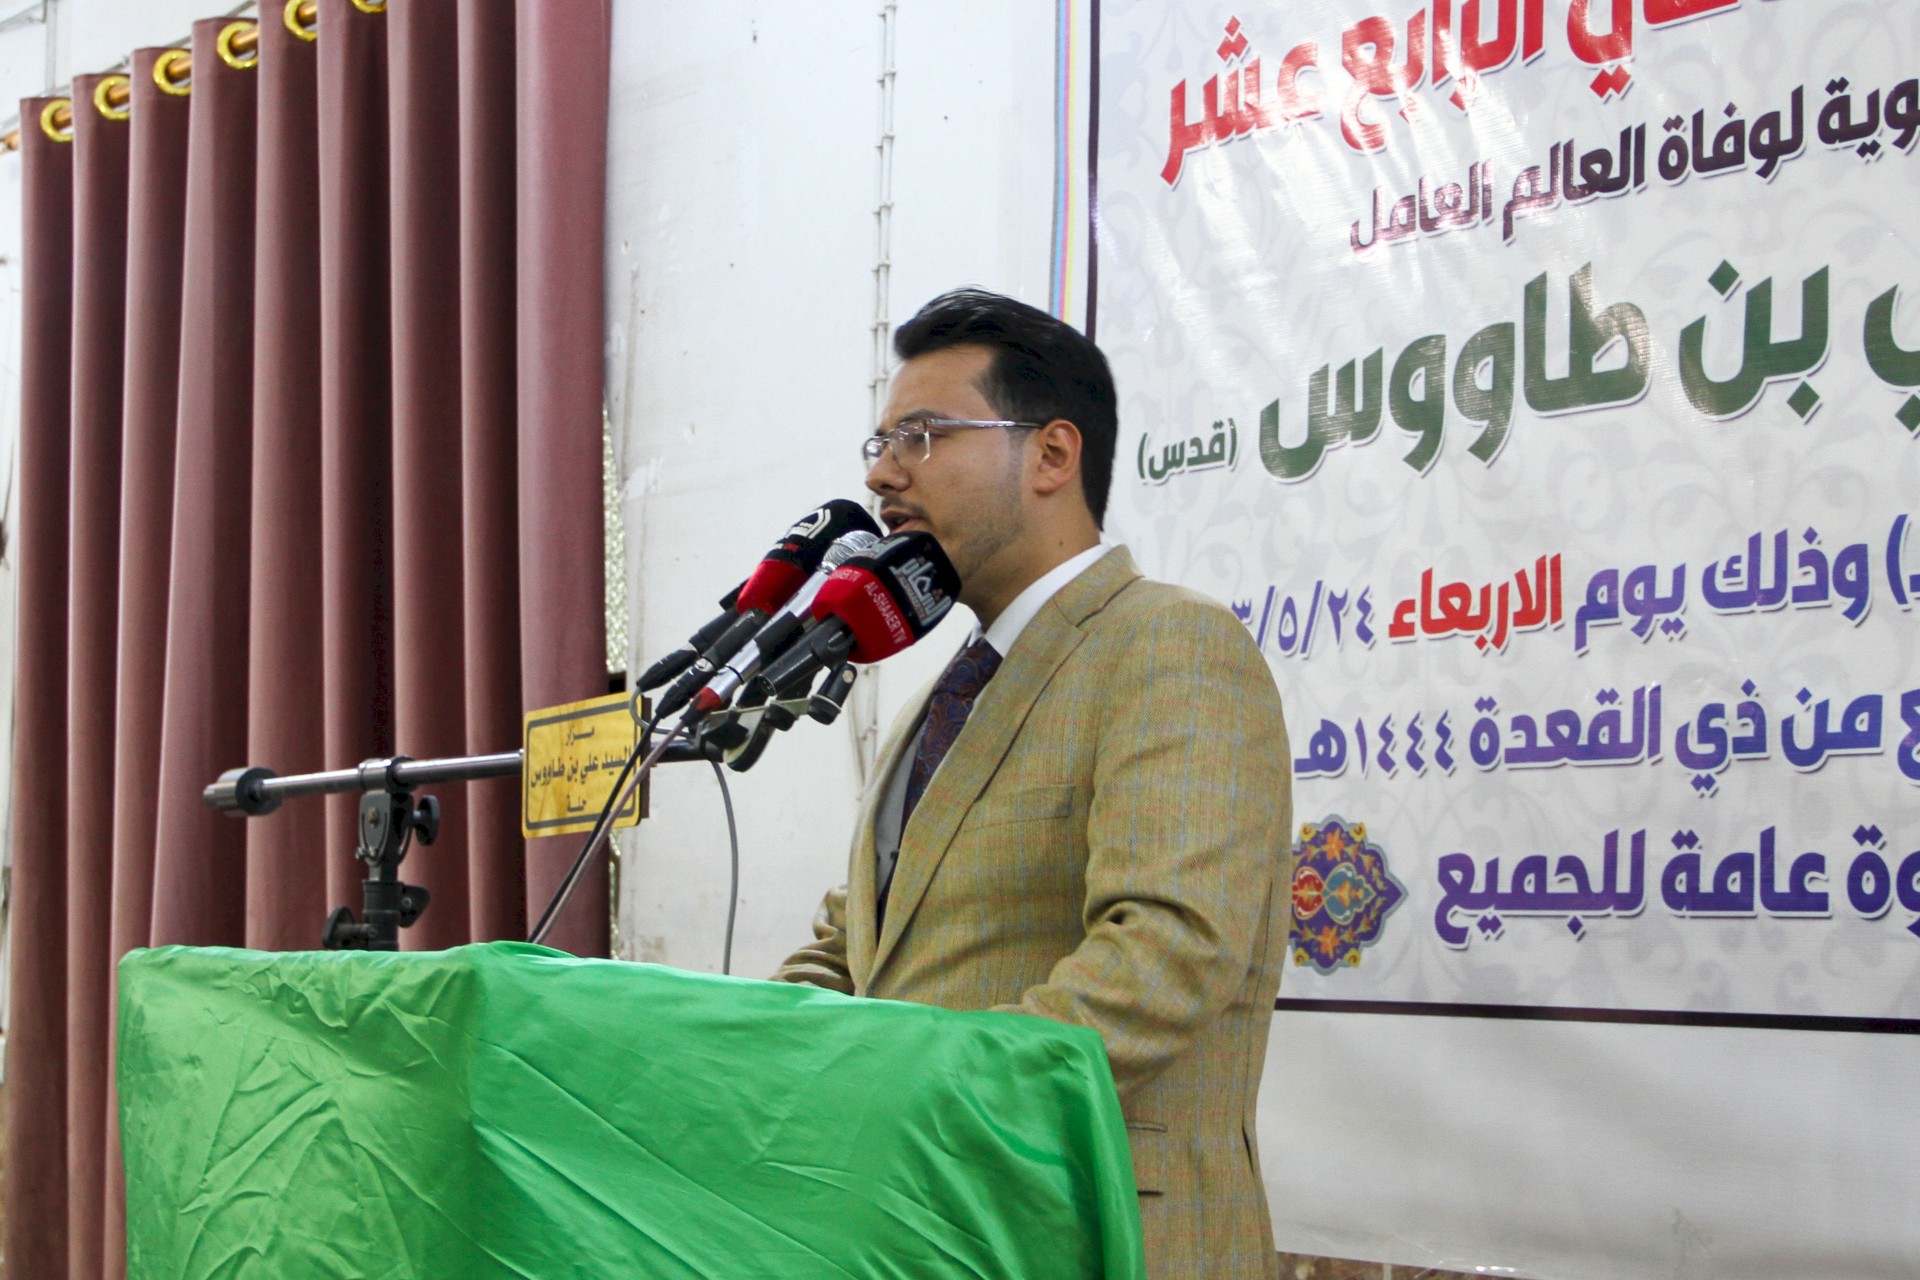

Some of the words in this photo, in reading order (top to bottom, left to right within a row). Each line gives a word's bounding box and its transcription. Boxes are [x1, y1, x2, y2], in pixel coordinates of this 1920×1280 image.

[1161, 16, 1320, 185] عشر
[1341, 0, 1545, 151] الرابع
[1659, 85, 1804, 180] لوفاة
[1350, 159, 1492, 254] العامل
[1502, 123, 1646, 243] العالم
[1259, 262, 1650, 478] طاووس
[1679, 259, 1829, 418] بن
[1138, 418, 1237, 480] (قدس)
[864, 580, 902, 632] AL-SHAAER
[892, 626, 908, 644] TV
[1388, 553, 1563, 651] الاربعاء
[1575, 563, 1686, 650] يوم
[1702, 527, 1869, 621] وذلك
[581, 752, 599, 785] علي
[1470, 682, 1662, 766] القعدة
[1675, 680, 1766, 791] ذي
[1781, 687, 1884, 767] من
[1434, 828, 1646, 944] للجميع
[1661, 825, 1829, 916] عامة
